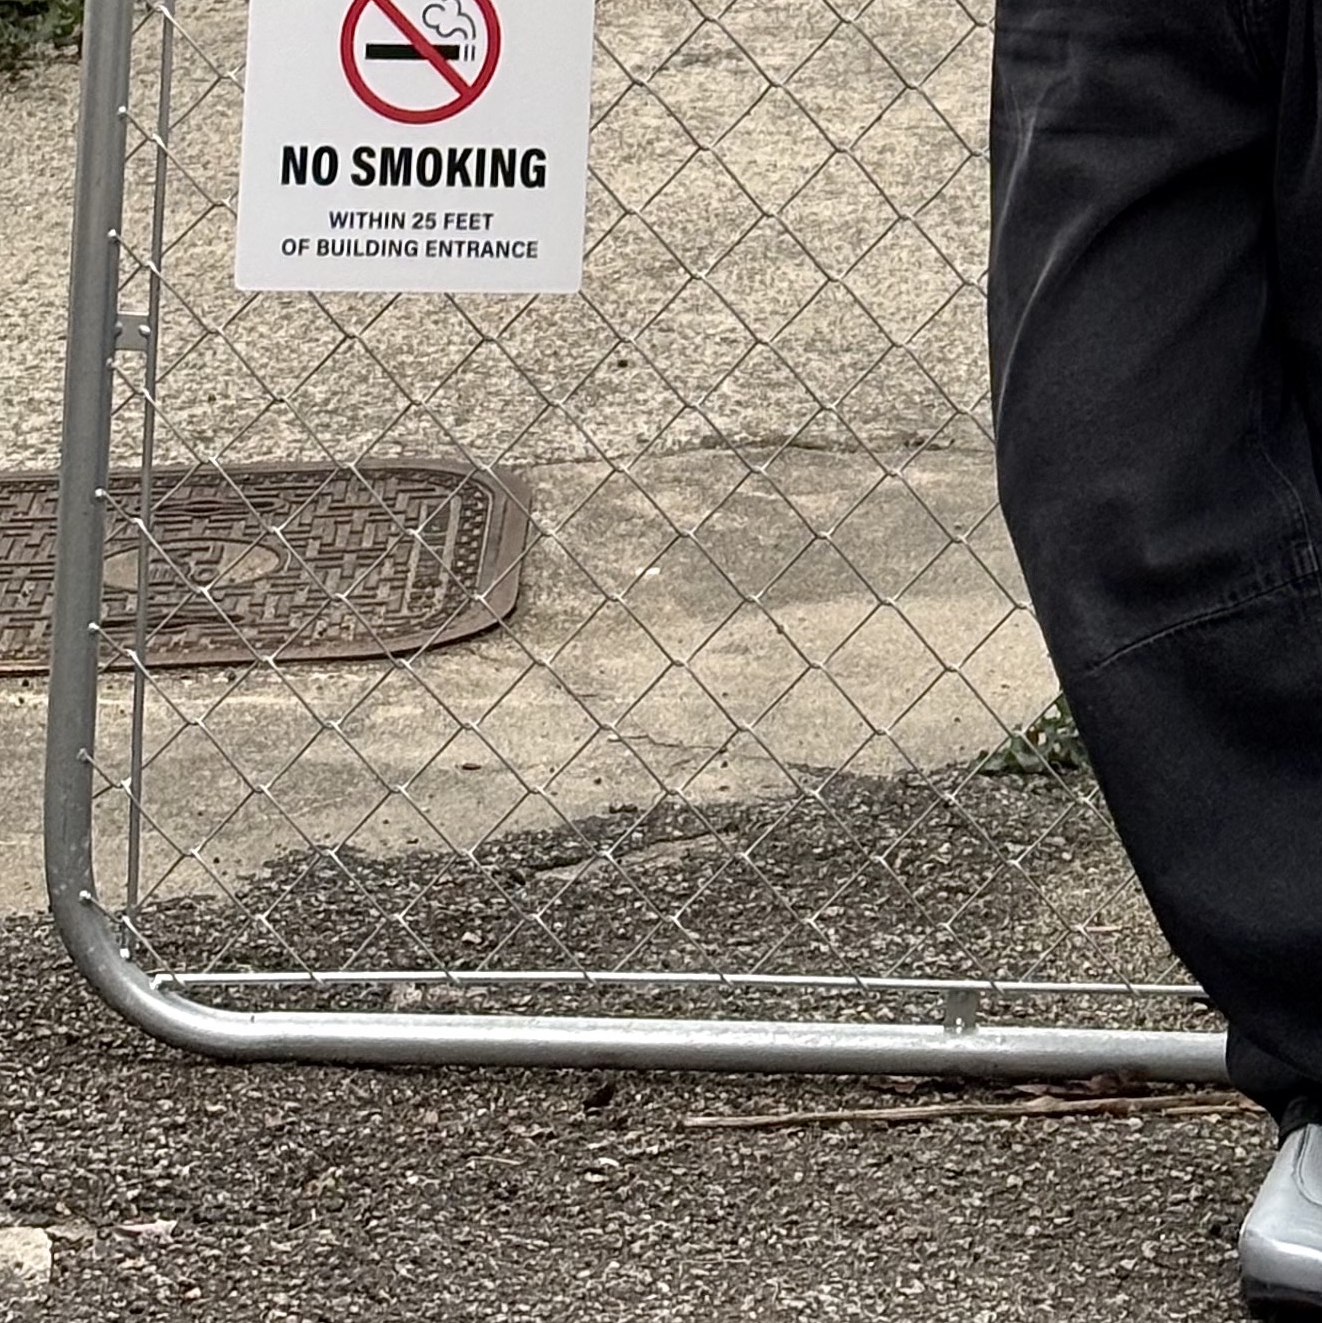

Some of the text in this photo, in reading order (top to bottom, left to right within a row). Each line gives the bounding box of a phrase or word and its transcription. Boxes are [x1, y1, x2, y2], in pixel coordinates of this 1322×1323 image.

[280, 145, 547, 188] NO SMOKING
[329, 211, 494, 231] WITHIN 25 FEET
[281, 238, 539, 259] OF BUILDING ENTRANCE
